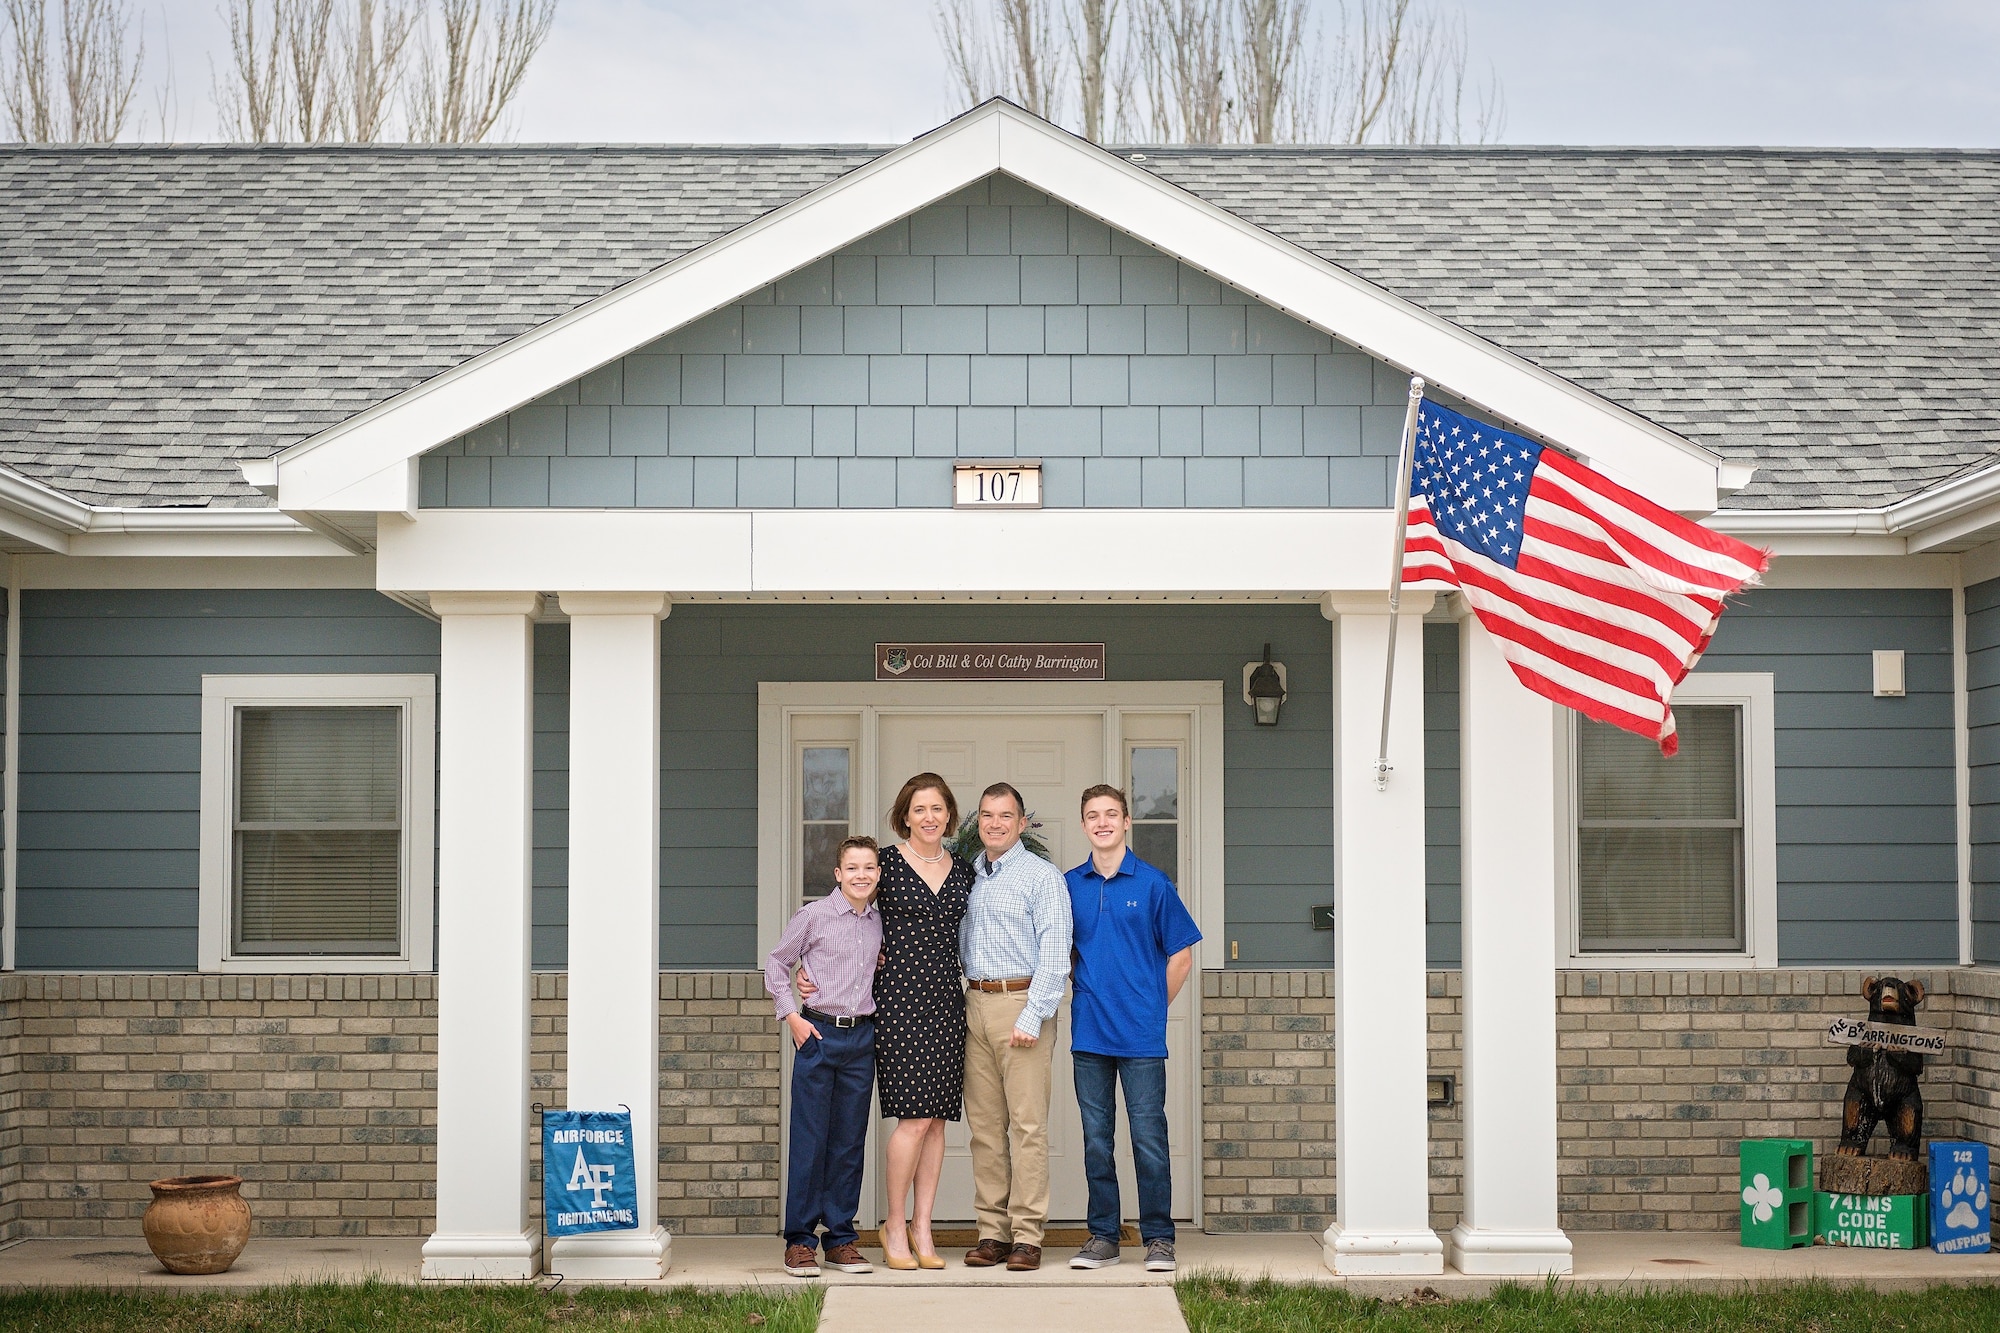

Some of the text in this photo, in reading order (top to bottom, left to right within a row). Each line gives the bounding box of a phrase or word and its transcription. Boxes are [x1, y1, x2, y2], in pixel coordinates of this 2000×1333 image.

[975, 472, 1020, 501] 107
[913, 654, 1098, 672] Col Bill & Col Cathy Barrington
[1953, 1151, 1973, 1163] 742
[566, 1145, 615, 1208] AF
[1829, 1194, 1892, 1212] 741 MS
[592, 1208, 633, 1223] FALCONS
[1838, 1212, 1886, 1229] CODE
[1827, 1230, 1900, 1248] CHANGE
[1937, 1232, 1991, 1253] WOLFPACK
